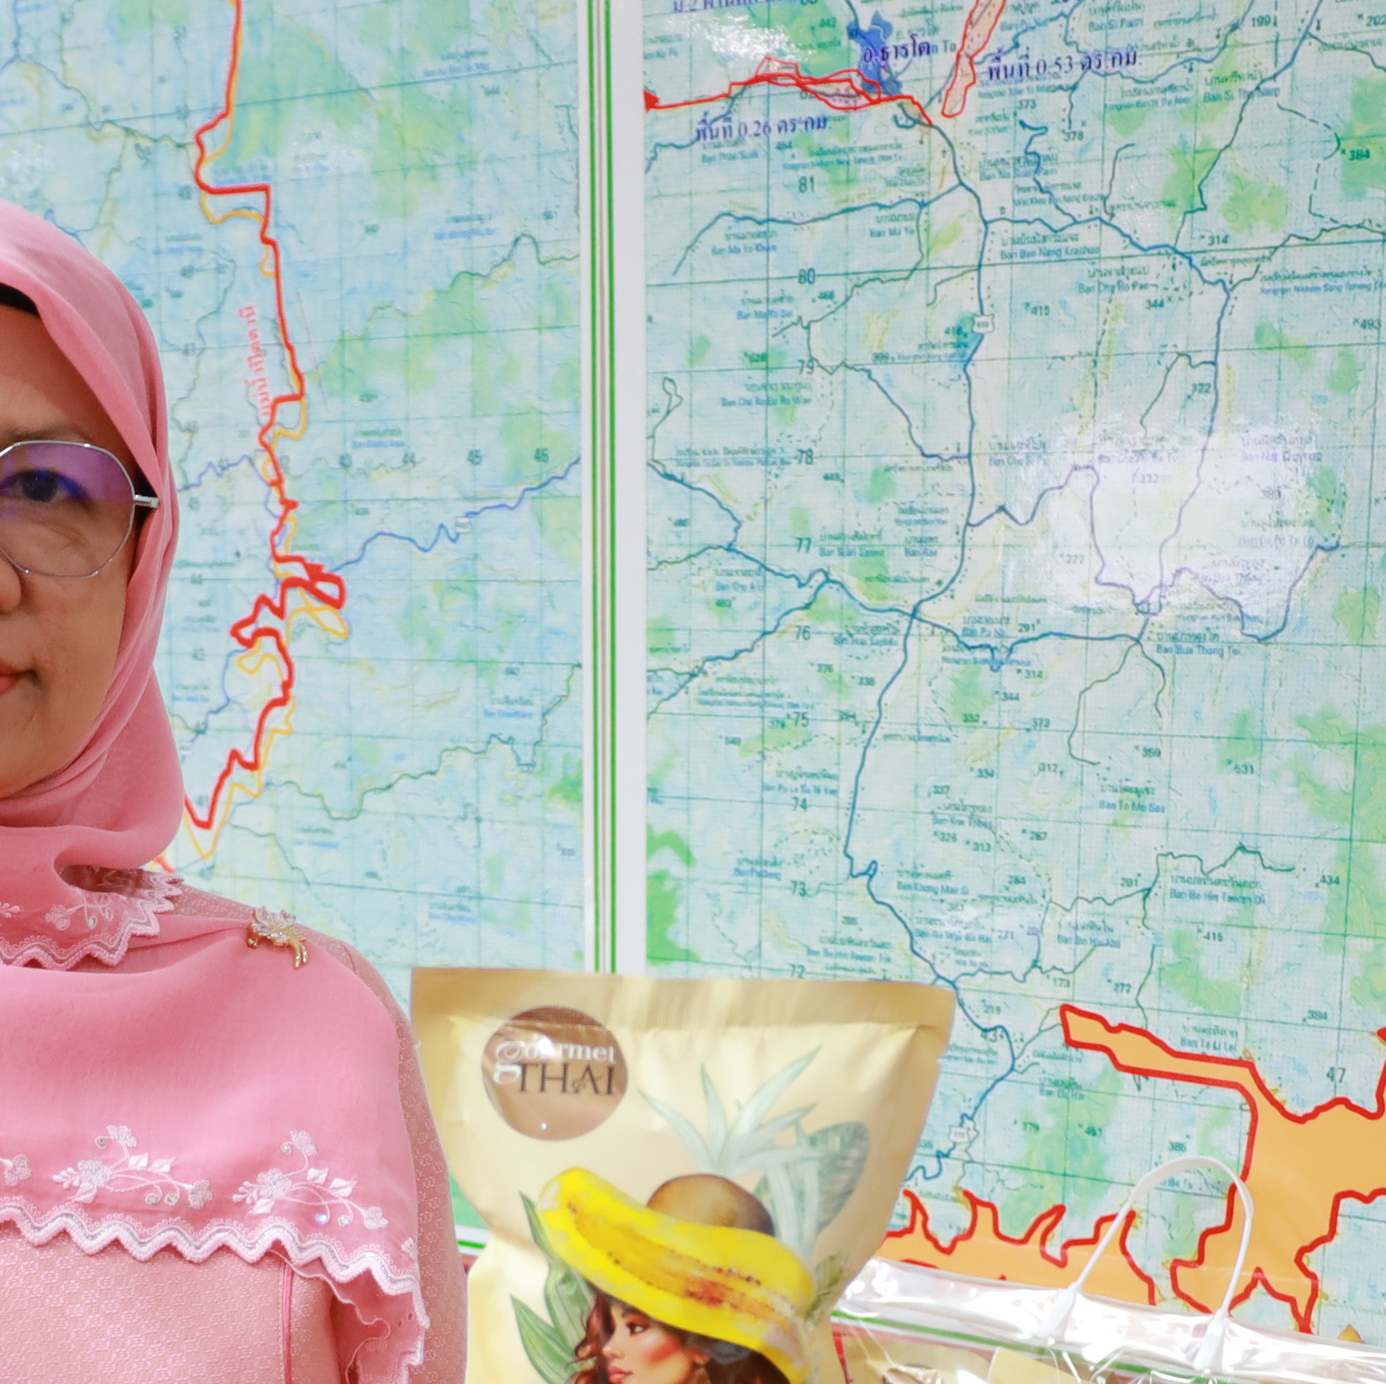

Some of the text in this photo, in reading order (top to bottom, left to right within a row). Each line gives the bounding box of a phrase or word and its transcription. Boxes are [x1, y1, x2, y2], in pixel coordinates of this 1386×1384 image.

[988, 46, 1031, 80] พื้นที่
[1036, 56, 1074, 77] 0.53
[739, 118, 771, 138] 0.26
[1349, 150, 1370, 161] 384
[798, 176, 815, 193] 81
[1208, 234, 1229, 246] 314
[798, 268, 816, 284] 80
[797, 360, 814, 375] 79
[1191, 383, 1212, 394] 322
[797, 449, 814, 465] 78
[797, 538, 811, 552] 77
[796, 625, 811, 641] 76
[795, 712, 809, 727] 75
[792, 797, 807, 811] 74
[791, 880, 806, 896] 73
[1320, 875, 1340, 886] 434
[790, 964, 805, 978] 72
[518, 1063, 614, 1095] THAI
[1326, 1067, 1346, 1083] 47
